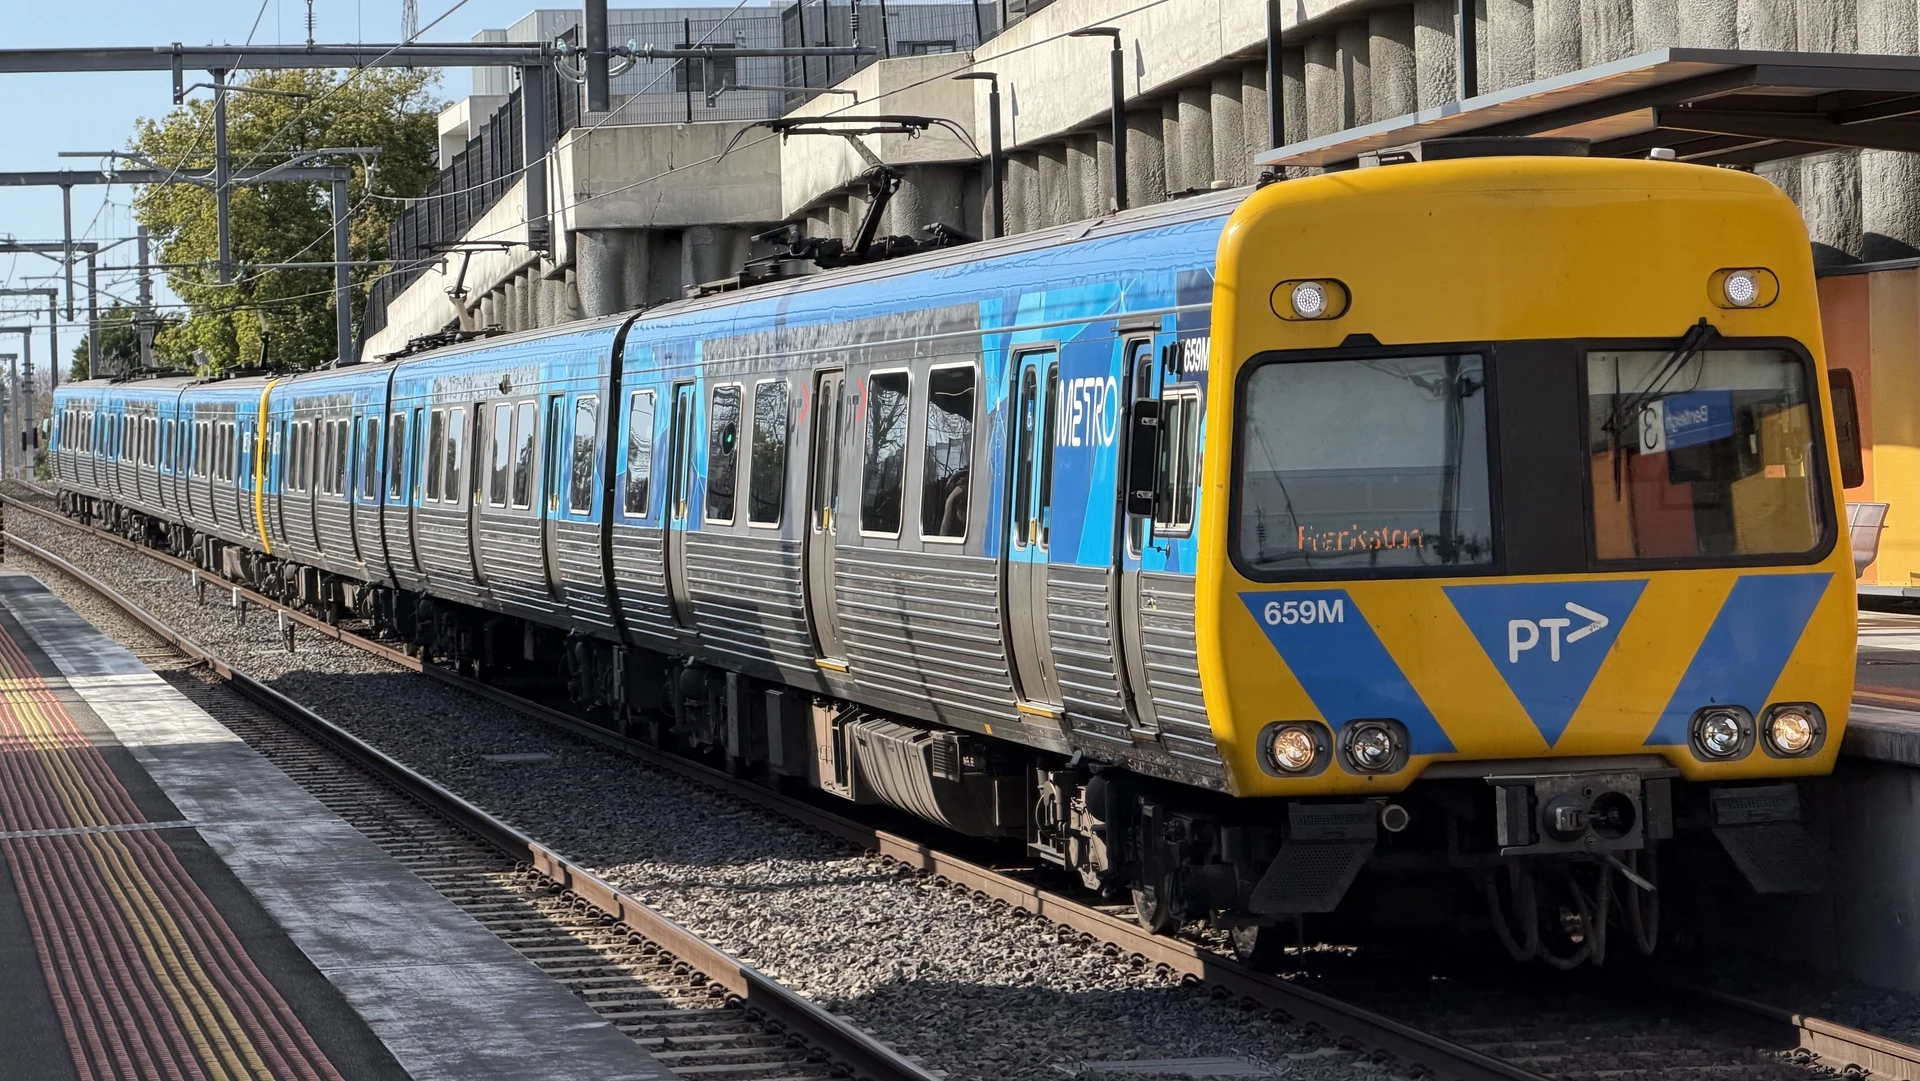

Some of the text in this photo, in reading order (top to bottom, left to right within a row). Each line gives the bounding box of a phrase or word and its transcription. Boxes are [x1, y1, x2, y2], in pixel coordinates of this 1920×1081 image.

[1184, 337, 1211, 372] 659M
[1057, 375, 1118, 447] METRO
[1264, 599, 1345, 626] 659M
